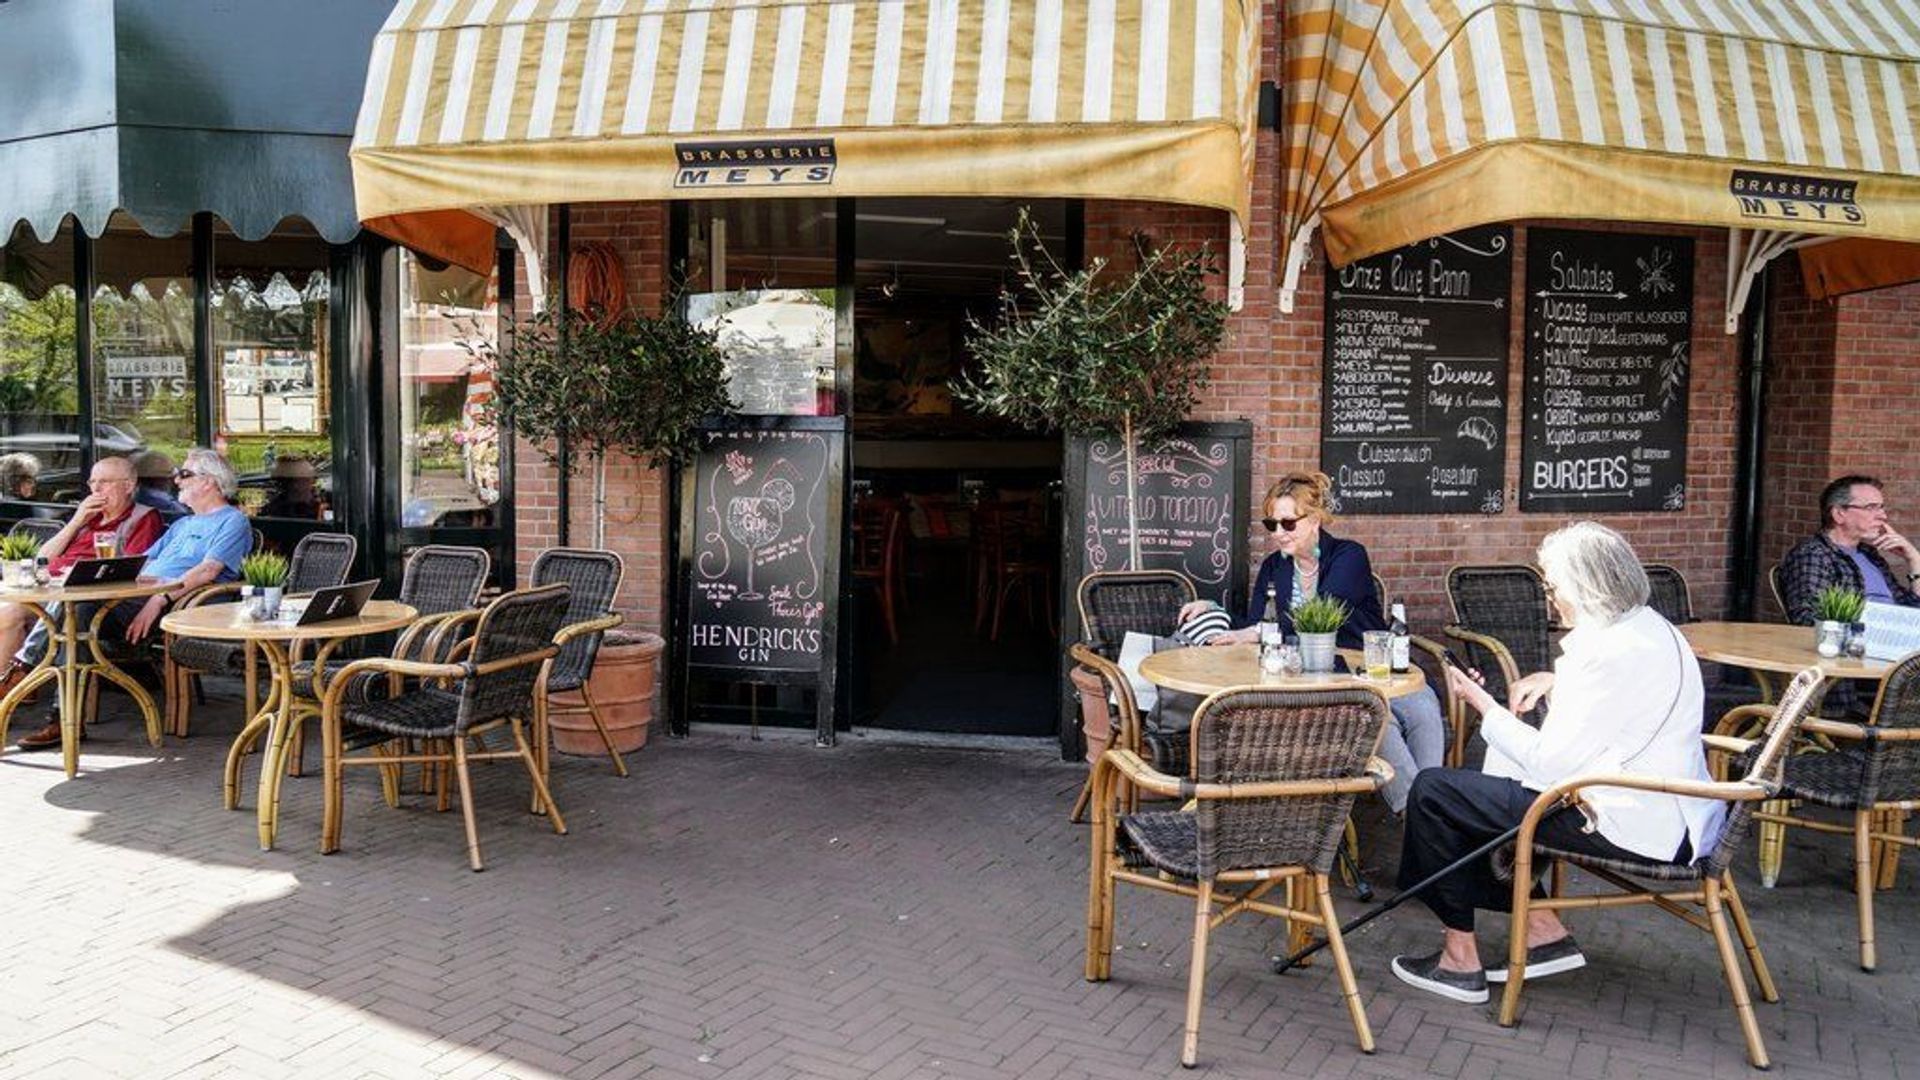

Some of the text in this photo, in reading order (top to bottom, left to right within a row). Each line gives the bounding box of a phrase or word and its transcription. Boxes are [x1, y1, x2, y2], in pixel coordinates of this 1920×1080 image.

[682, 146, 831, 162] BRASSERIE
[680, 166, 829, 184] MEYS
[1734, 178, 1851, 200] BRASSERIE
[1741, 197, 1862, 222] MEYS
[1550, 250, 1614, 291] Salades
[108, 361, 184, 373] BRASSERIE
[1340, 360, 1370, 371] MEYS
[1427, 362, 1496, 386] Diverse
[108, 378, 185, 398] MEYS
[224, 380, 305, 394] MEYS
[1533, 455, 1628, 490] BURGERS
[692, 624, 820, 653] HENDRICK'S
[738, 648, 770, 662] GIN
